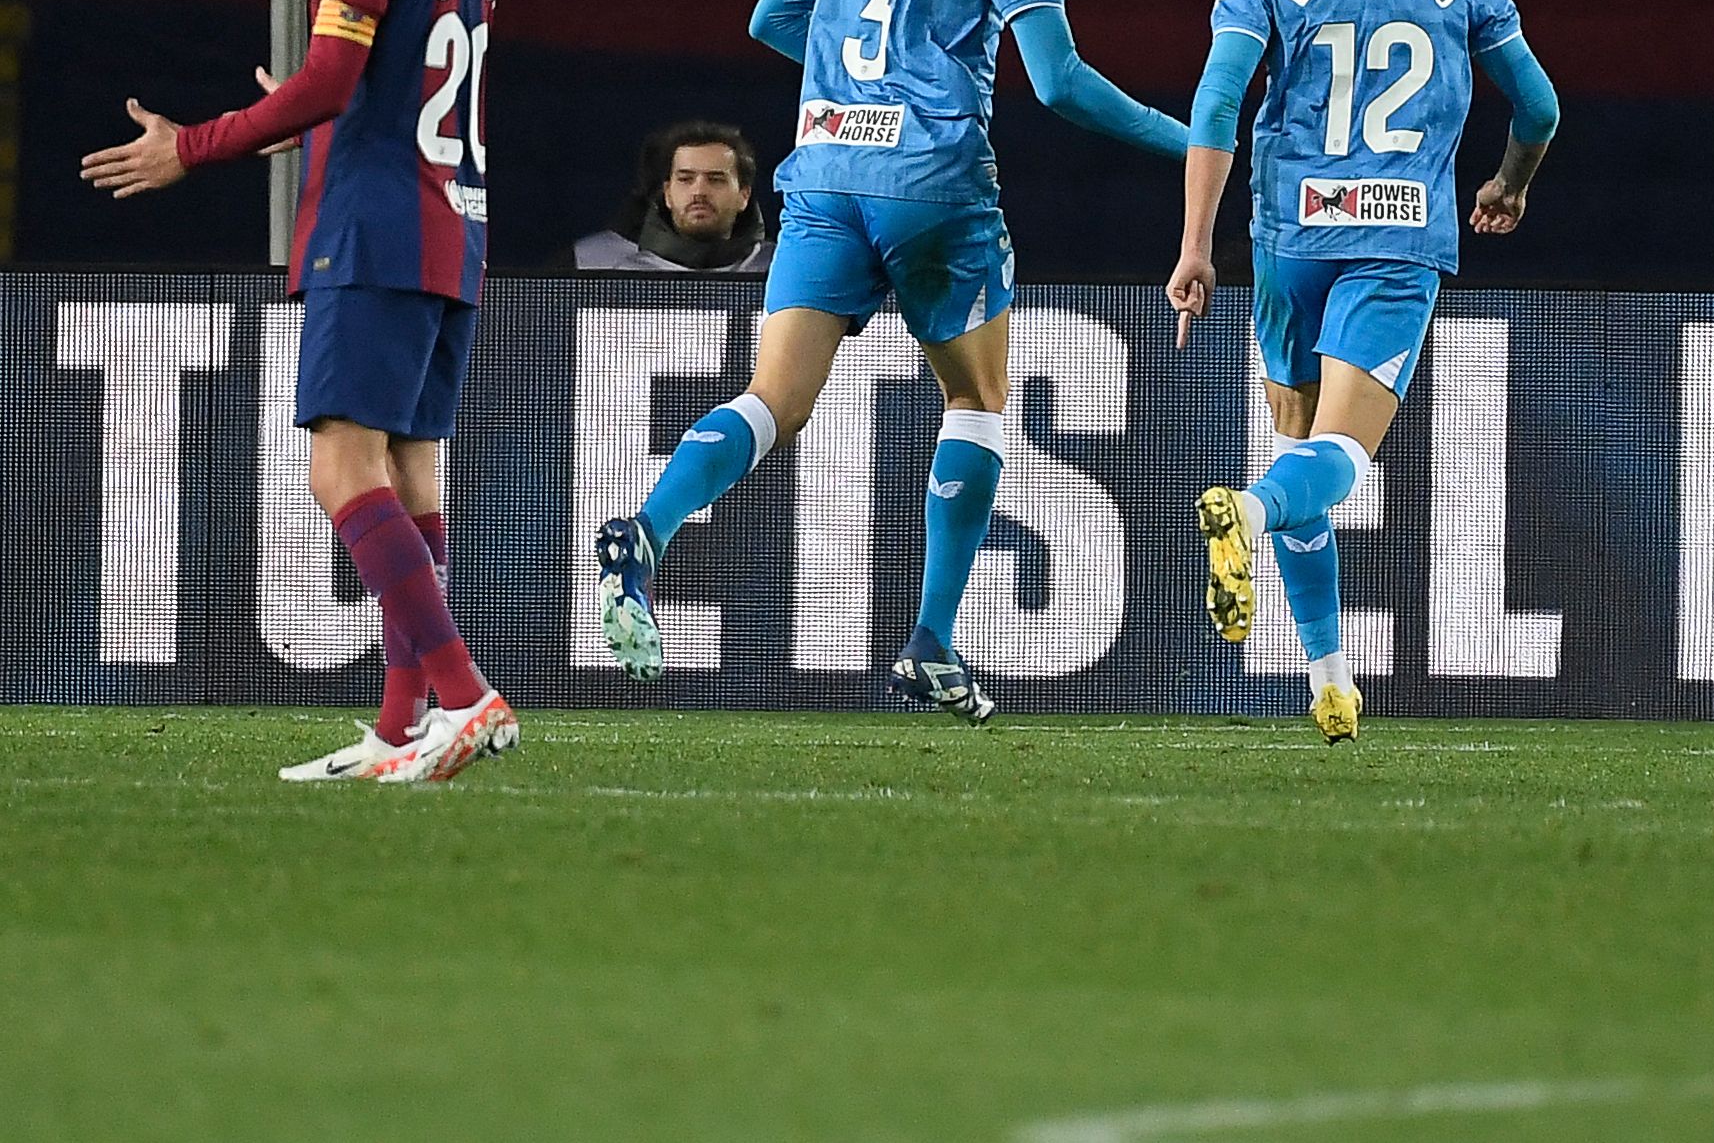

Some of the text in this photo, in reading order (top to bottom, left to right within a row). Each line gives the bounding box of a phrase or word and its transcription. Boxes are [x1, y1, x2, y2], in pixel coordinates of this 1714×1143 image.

[416, 11, 488, 175] 20
[1311, 21, 1435, 157] 12
[845, 109, 900, 126] POWER
[839, 126, 898, 143] HORSE
[1360, 183, 1421, 203] POWER
[1360, 202, 1422, 222] HORSE
[570, 308, 1128, 677] ETS
